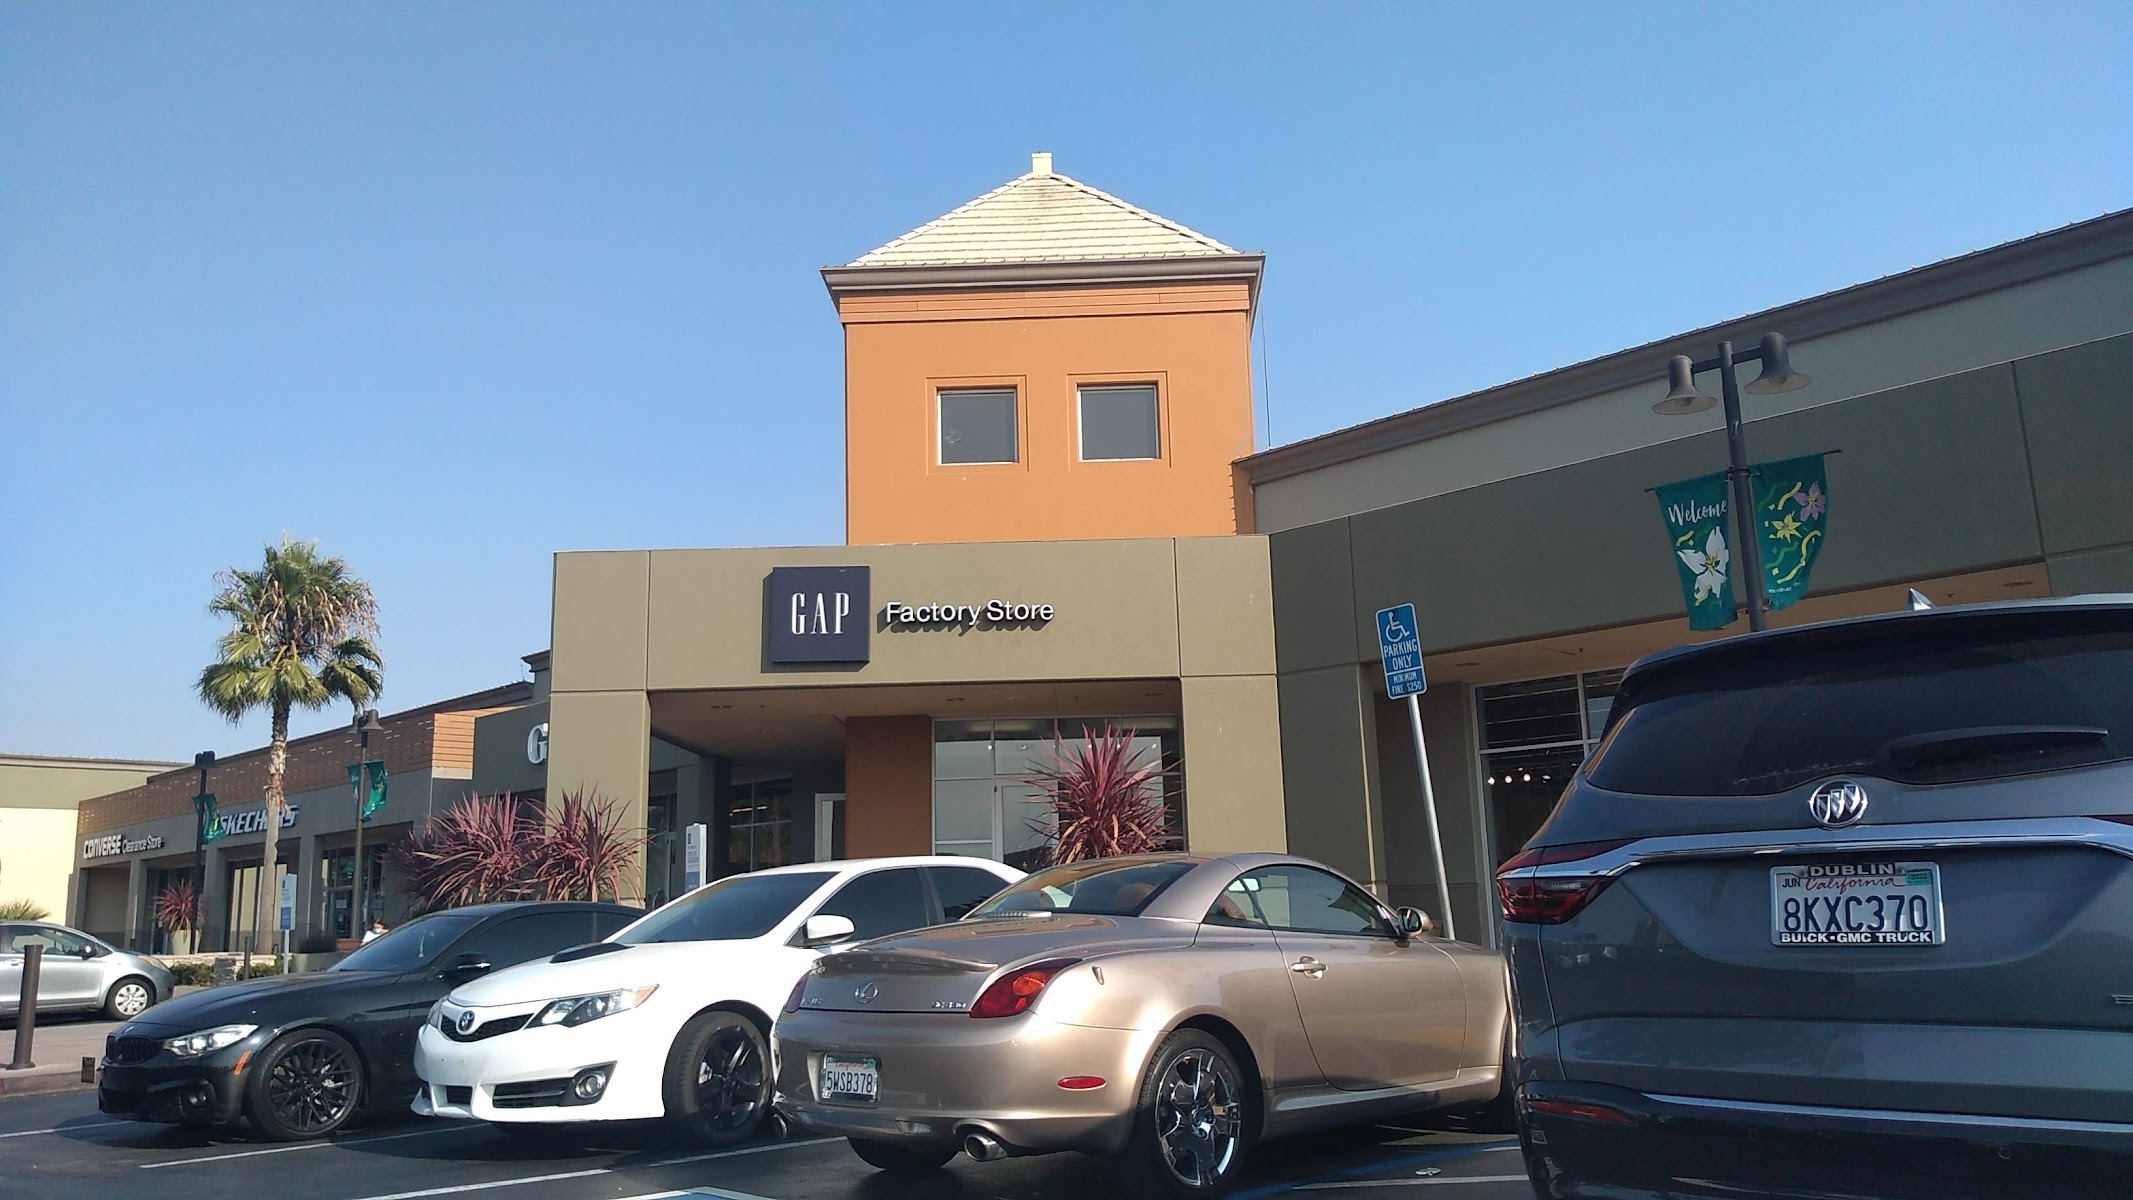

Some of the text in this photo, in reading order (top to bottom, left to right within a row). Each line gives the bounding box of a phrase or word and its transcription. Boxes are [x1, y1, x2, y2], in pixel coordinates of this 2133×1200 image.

[1668, 499, 1727, 526] Welcome
[791, 592, 849, 635] GAP
[886, 599, 1054, 625] Factory Store
[1383, 639, 1417, 658] PARKING
[1392, 654, 1412, 670] ONLY
[1391, 680, 1422, 695] FINE $250
[1393, 671, 1417, 684] MINIMUM
[220, 804, 297, 835] SKECHRS
[83, 834, 162, 859] CONVERSE Clearance Store
[1810, 863, 1895, 877] DUBLIN
[1782, 877, 1800, 888] JUN
[1805, 876, 1906, 895] California
[1783, 894, 1928, 932] 8KXC370
[1876, 931, 1931, 942] TRUCK
[826, 1070, 873, 1093] 5WSB378
